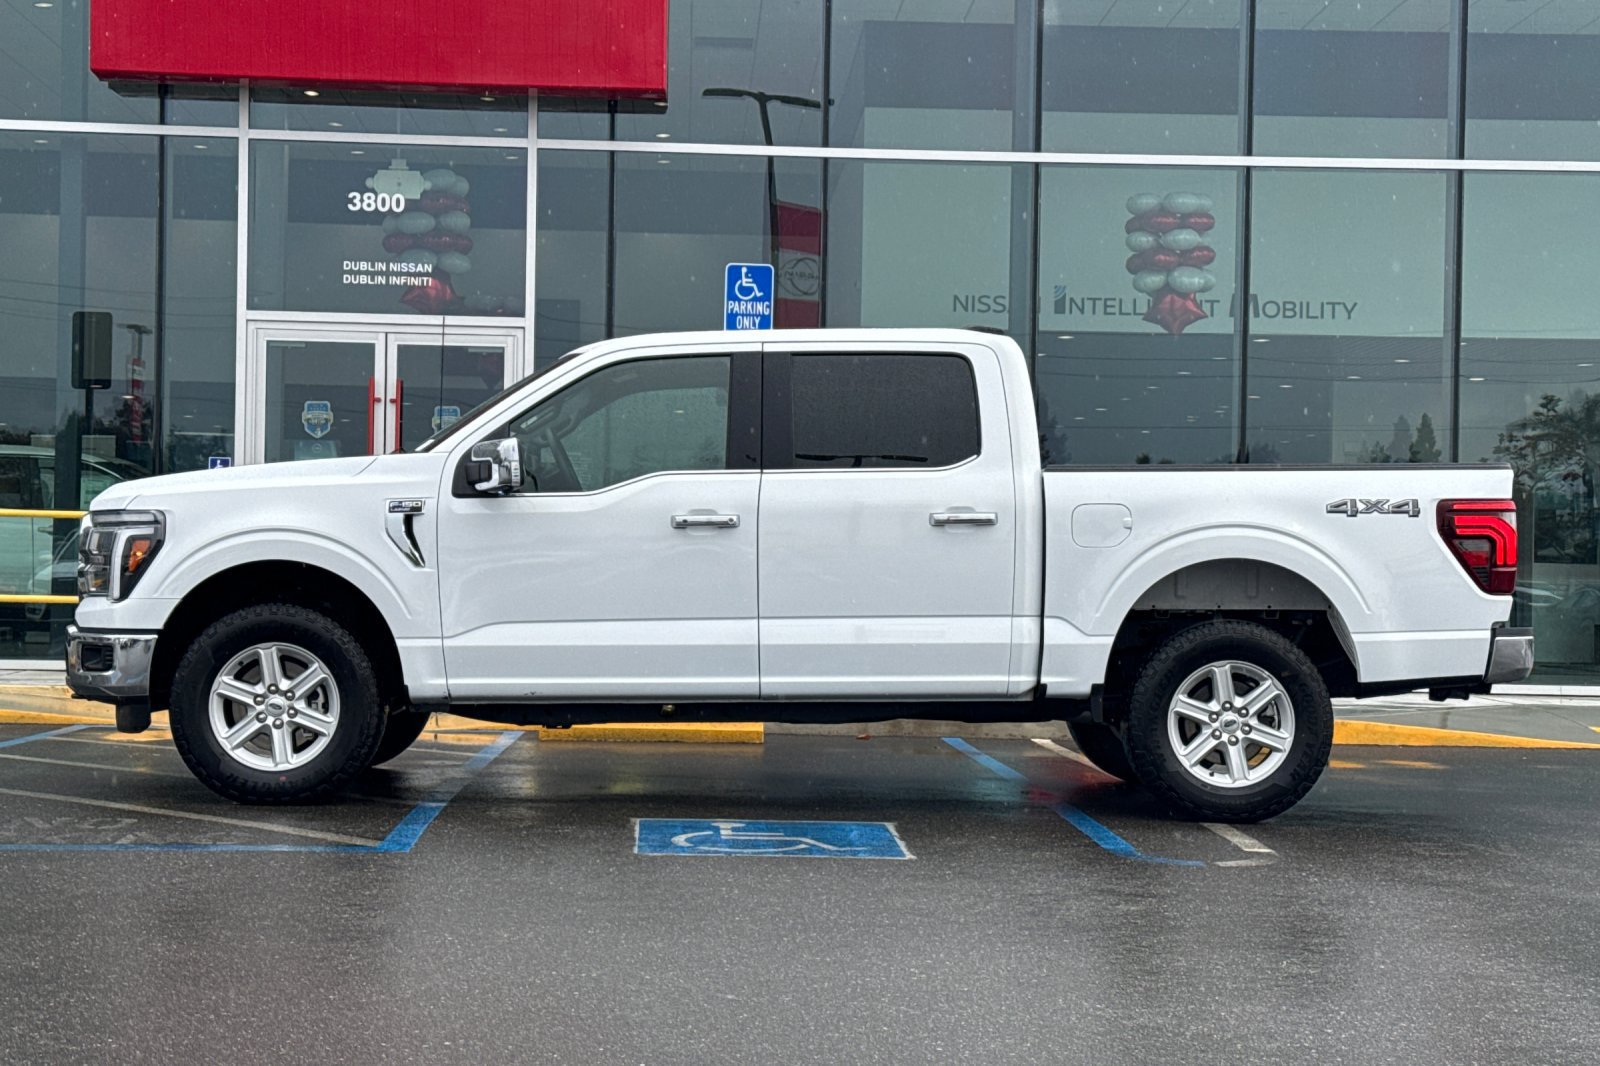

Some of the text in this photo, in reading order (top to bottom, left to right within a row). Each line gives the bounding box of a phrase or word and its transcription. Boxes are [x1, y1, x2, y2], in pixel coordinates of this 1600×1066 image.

[347, 191, 405, 213] 3800
[343, 260, 433, 273] DUBLIN NISSAN
[343, 274, 433, 287] DUBLIN INFINITI
[728, 300, 771, 315] PARKING
[952, 293, 1039, 313] NISS
[736, 315, 761, 329] ONLY
